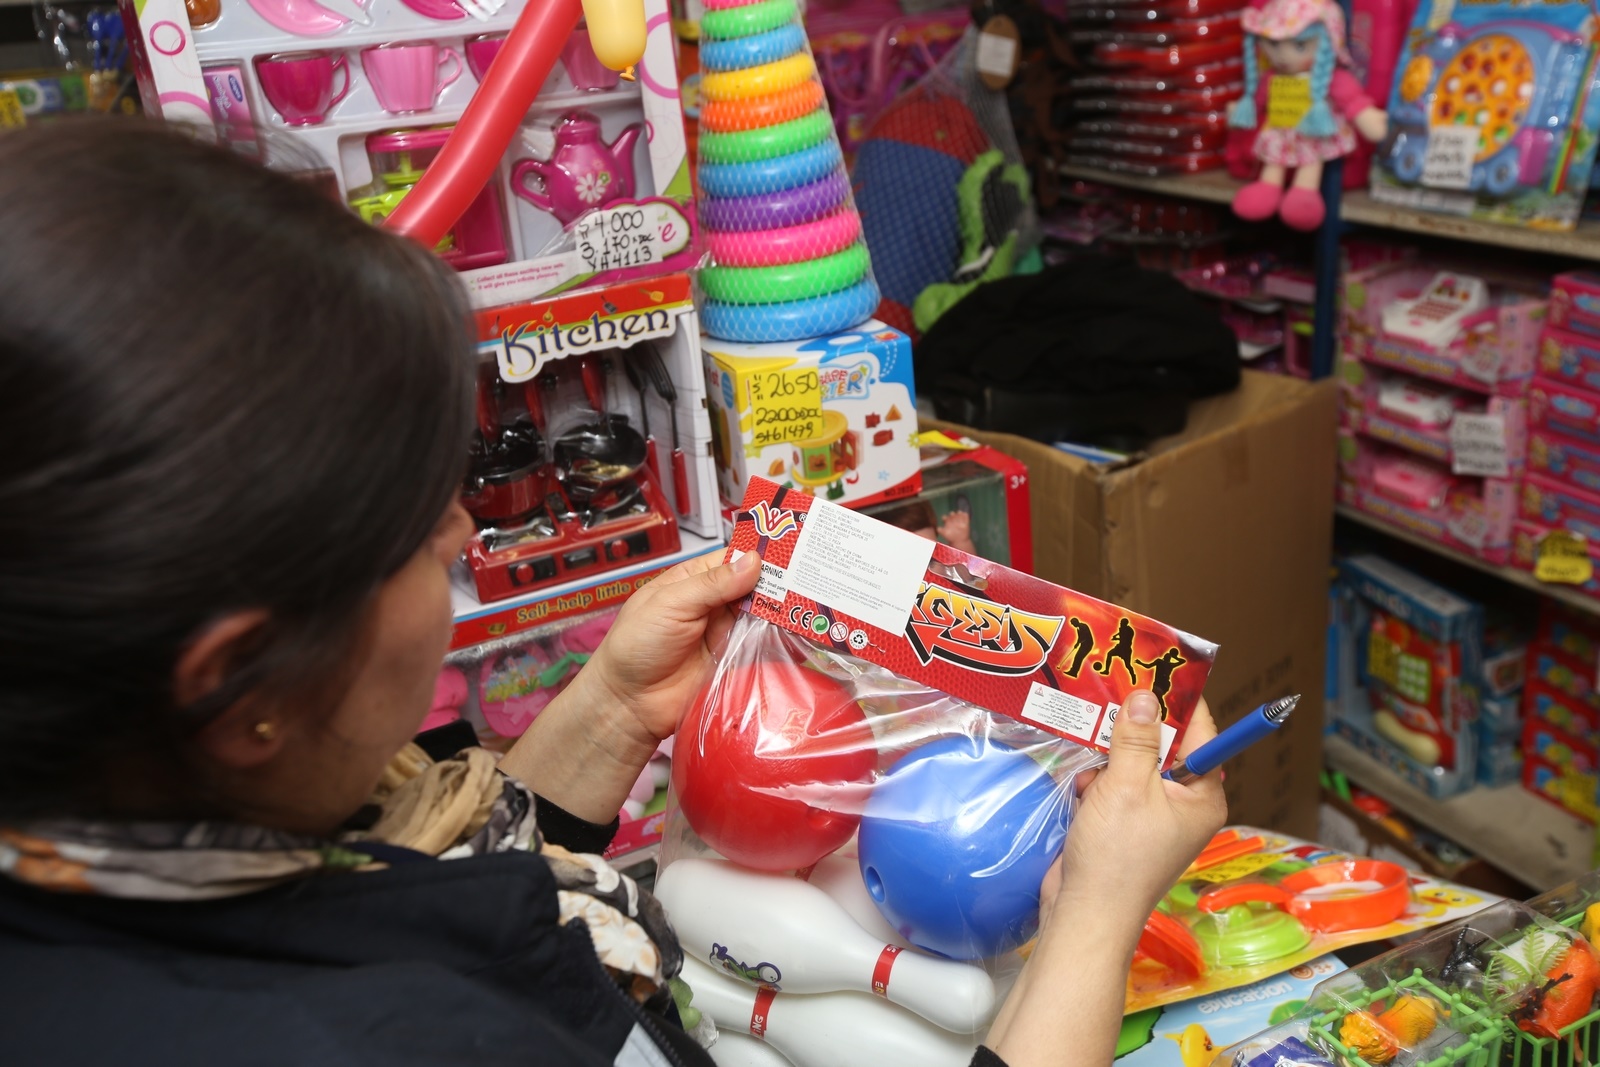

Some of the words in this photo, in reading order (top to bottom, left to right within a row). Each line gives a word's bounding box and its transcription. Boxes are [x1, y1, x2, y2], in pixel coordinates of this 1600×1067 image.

[595, 210, 645, 237] 4.000
[580, 234, 630, 259] 3.170
[501, 308, 670, 377] Kitchen
[767, 371, 818, 398] 2650
[1011, 474, 1026, 490] 3+
[761, 563, 784, 579] ARNING:
[517, 590, 593, 624] Self-help
[596, 580, 631, 602] little
